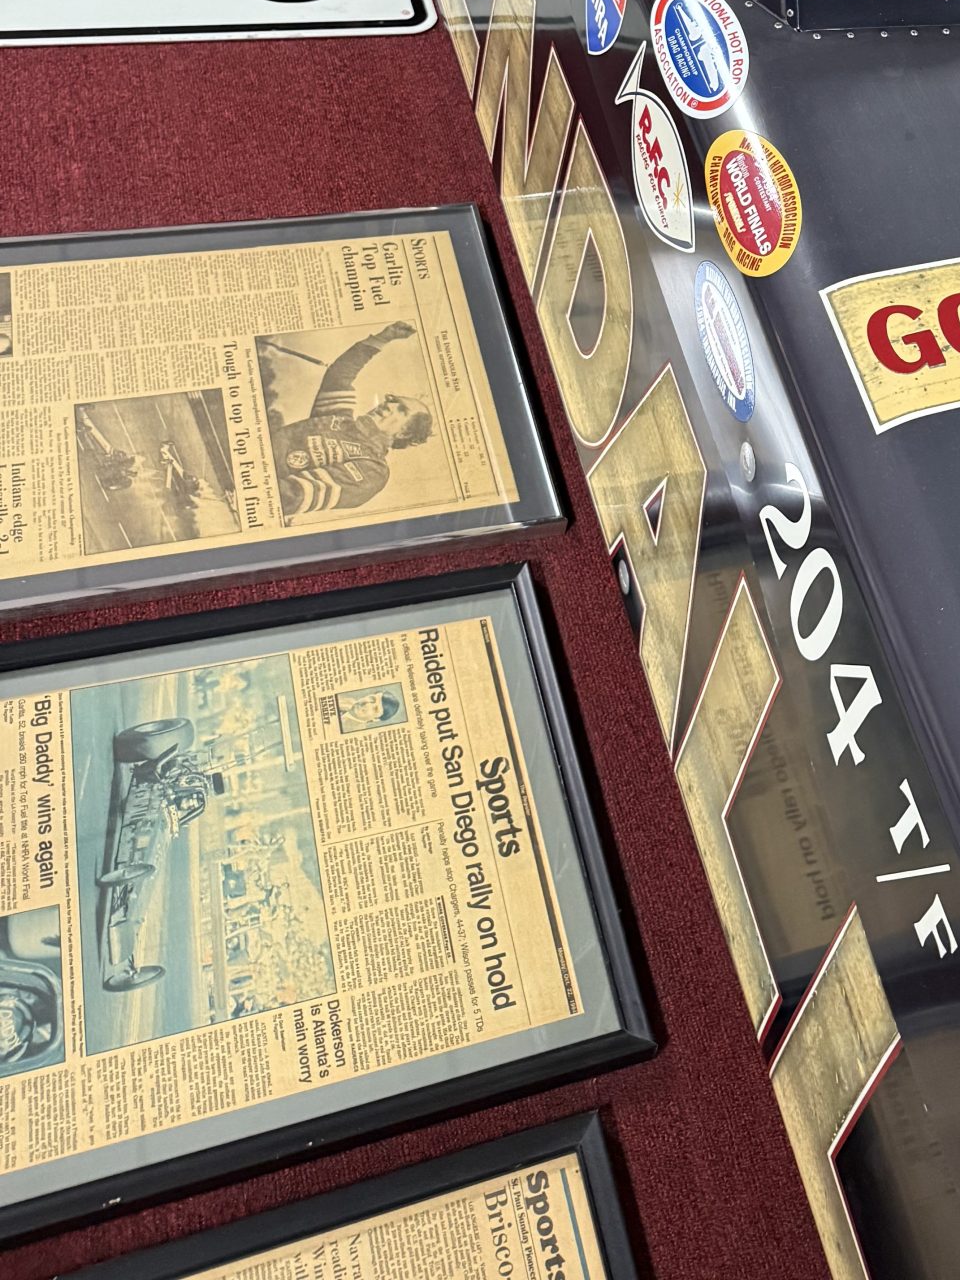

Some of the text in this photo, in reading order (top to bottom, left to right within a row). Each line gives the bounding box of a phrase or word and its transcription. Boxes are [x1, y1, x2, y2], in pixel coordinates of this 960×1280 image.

[674, 28, 699, 77] CHAMPIONSHIP
[727, 31, 743, 54] HOT
[653, 28, 689, 104] ASSOCIATION
[667, 35, 690, 78] DRAG RACING
[736, 153, 751, 179] Winston
[648, 172, 657, 199] FOR
[739, 136, 798, 249] NANAL HOT ROD ASSOCIATION
[753, 176, 773, 212] CONTESTANT
[711, 155, 725, 224] CHAMPIONSHIP
[736, 249, 764, 271] RACING
[725, 158, 752, 206] WORLD
[745, 206, 773, 255] FINALS
[381, 241, 404, 286] Garlits
[410, 238, 430, 280] SPORTS
[340, 245, 366, 311] champion
[361, 242, 391, 306] Top Fuel
[222, 340, 264, 529] Tough to top Top Fuel final
[262, 473, 271, 486] Top
[9, 461, 28, 543] Indians edge
[264, 486, 274, 499] Fuel
[267, 499, 275, 518] victory
[406, 663, 417, 691] Referees
[17, 698, 26, 719] Garlits,
[410, 692, 419, 703] are
[413, 703, 425, 730] definitely
[759, 462, 959, 959] 204 T/F
[17, 719, 26, 730] 52,
[18, 730, 26, 752] breaks
[419, 730, 429, 751] taking
[422, 750, 432, 765] over
[18, 765, 27, 780] mph
[19, 780, 28, 789] for
[425, 766, 434, 778] the
[18, 789, 28, 803] Top
[29, 694, 58, 889] 'Big Daddy' wins again
[426, 778, 438, 798] game
[19, 804, 29, 819] Fuel
[417, 627, 517, 1011] Raiders put San Diego rally on hold
[479, 756, 521, 859] Sports
[20, 818, 28, 831] title
[20, 832, 28, 840] at
[436, 821, 447, 846] Penalty
[20, 839, 30, 862] NHRA
[441, 847, 451, 866] helps
[20, 861, 30, 883] World
[444, 866, 454, 882] stop
[22, 882, 31, 900] Final
[448, 882, 460, 918] Chargers,
[459, 941, 471, 968] Wilson
[463, 968, 476, 995] passes
[563, 971, 572, 987] Oct.
[470, 996, 479, 1007] for
[326, 999, 346, 1068] Dickerson
[474, 1014, 485, 1033] TDs
[292, 1008, 312, 1083] main worry
[309, 1003, 331, 1078] is Atlanta's
[510, 1177, 519, 1190] St.
[513, 1190, 524, 1211] Paul
[517, 1211, 529, 1244] Sunday
[526, 1170, 566, 1280] Sports
